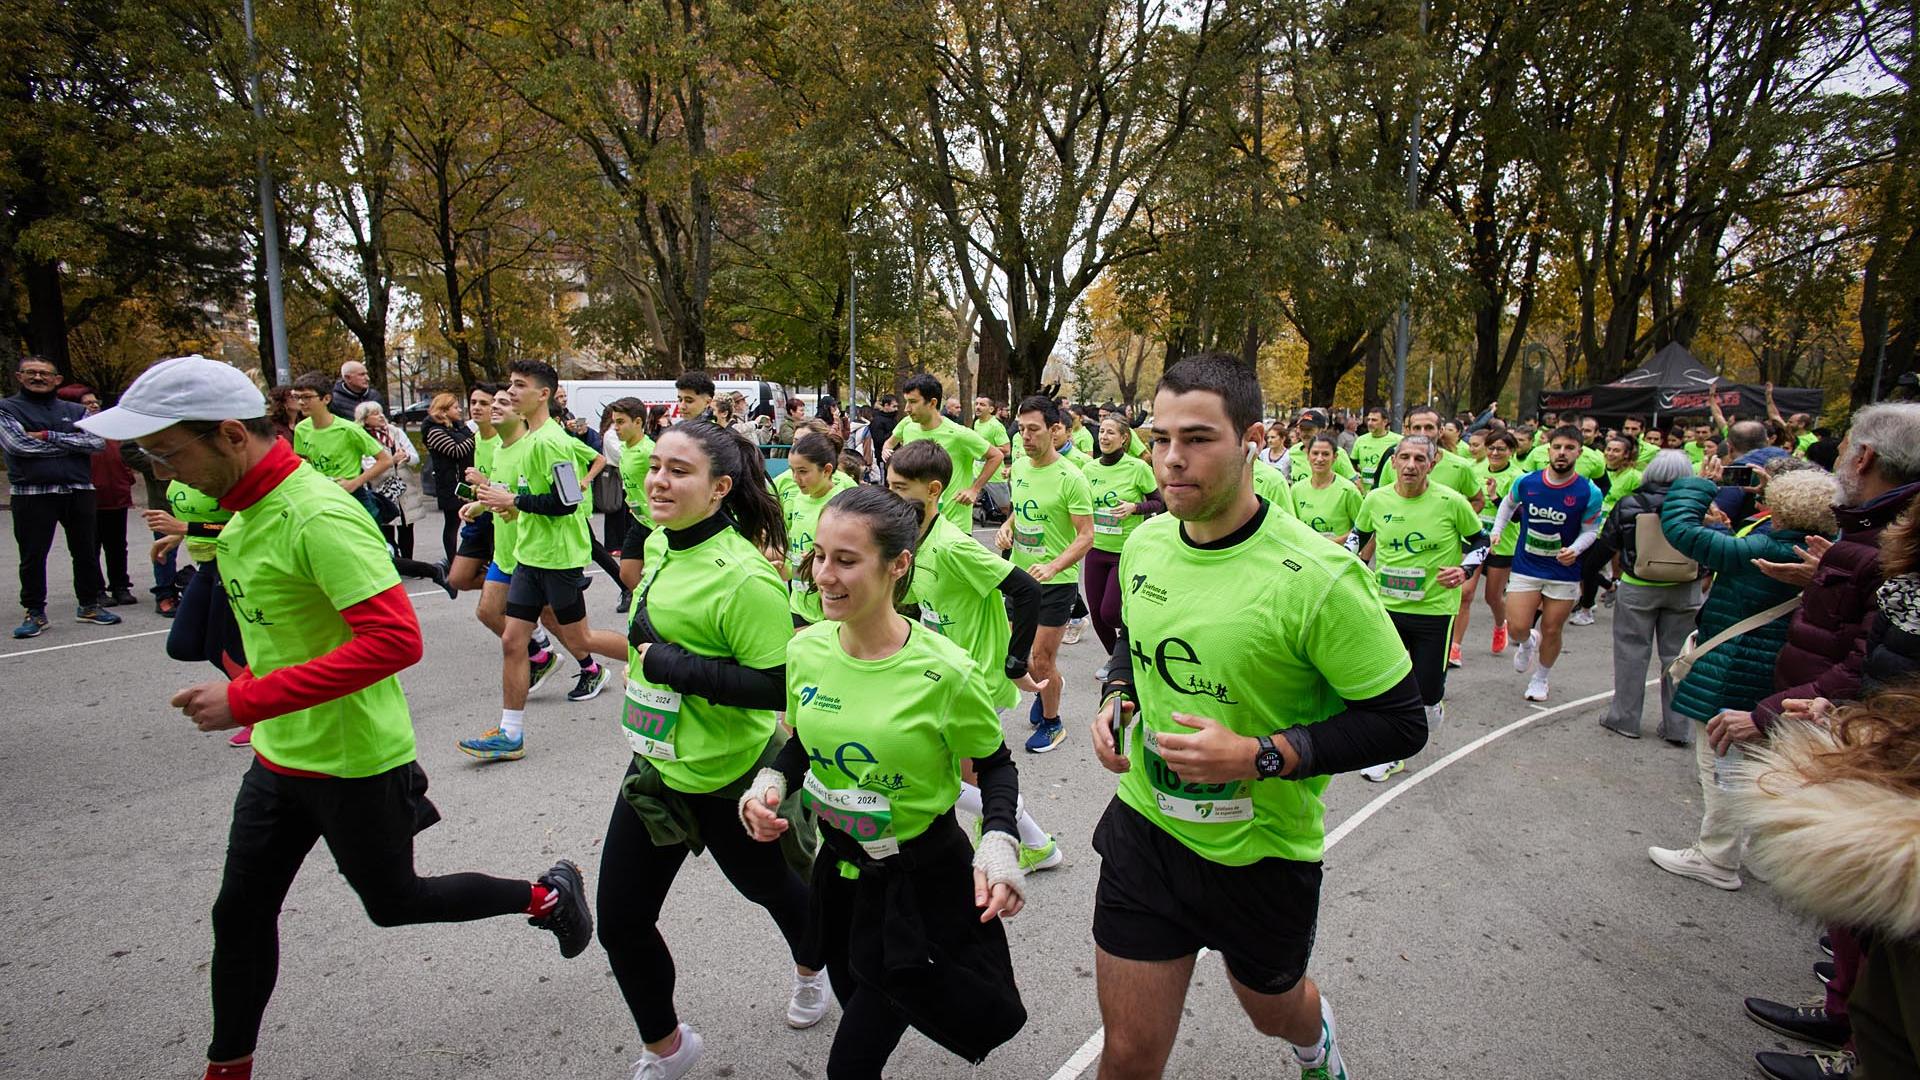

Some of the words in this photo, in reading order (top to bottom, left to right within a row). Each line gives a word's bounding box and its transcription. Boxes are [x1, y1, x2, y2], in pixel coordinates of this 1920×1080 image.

[1529, 503, 1567, 522] beko
[655, 695, 671, 705] 2024
[857, 796, 877, 805] 2024
